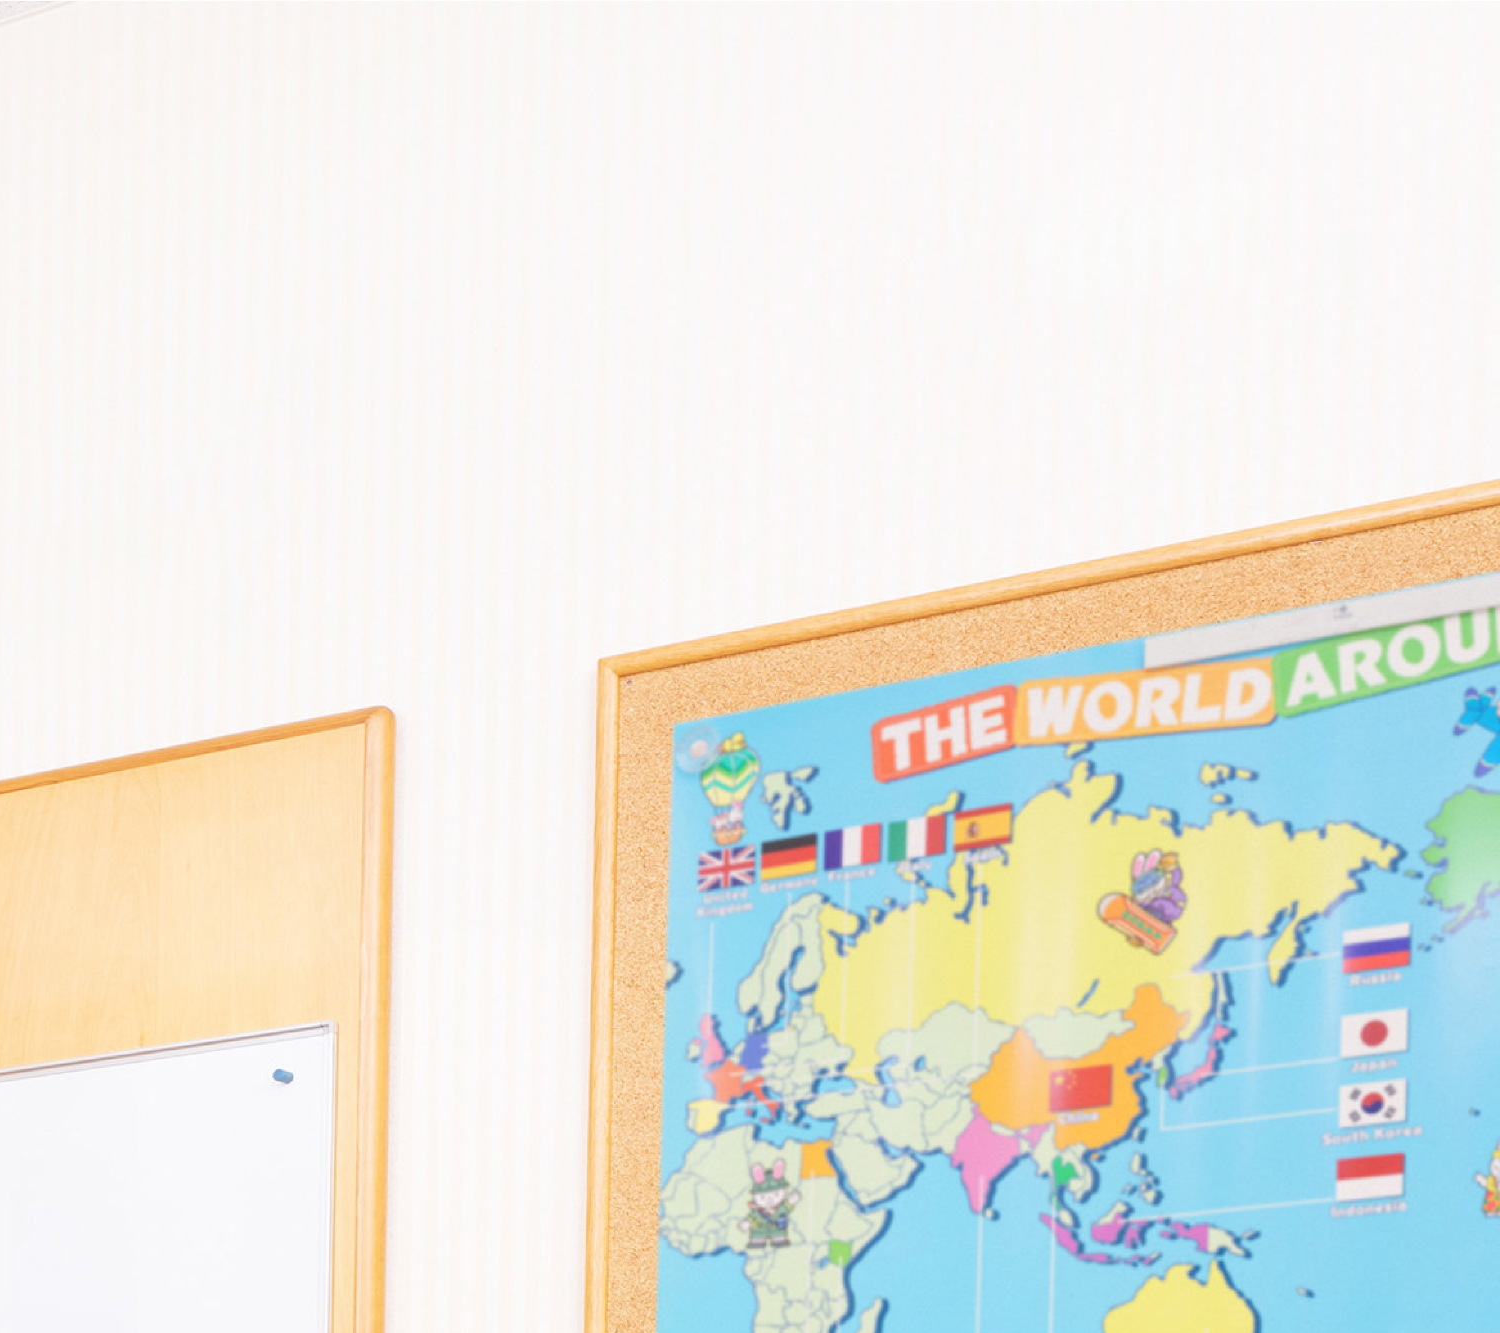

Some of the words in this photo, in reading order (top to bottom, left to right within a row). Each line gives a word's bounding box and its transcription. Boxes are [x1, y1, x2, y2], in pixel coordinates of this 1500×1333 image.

[880, 694, 1009, 771] THE
[1028, 668, 1272, 737] WORLD
[1285, 607, 1500, 706] AROU
[761, 877, 818, 893] Germany
[1350, 970, 1401, 986] Russia
[1350, 1058, 1397, 1073] Japan
[1322, 1131, 1369, 1146] South
[1374, 1125, 1422, 1139] Korea
[1331, 1201, 1406, 1218] Indonesia
